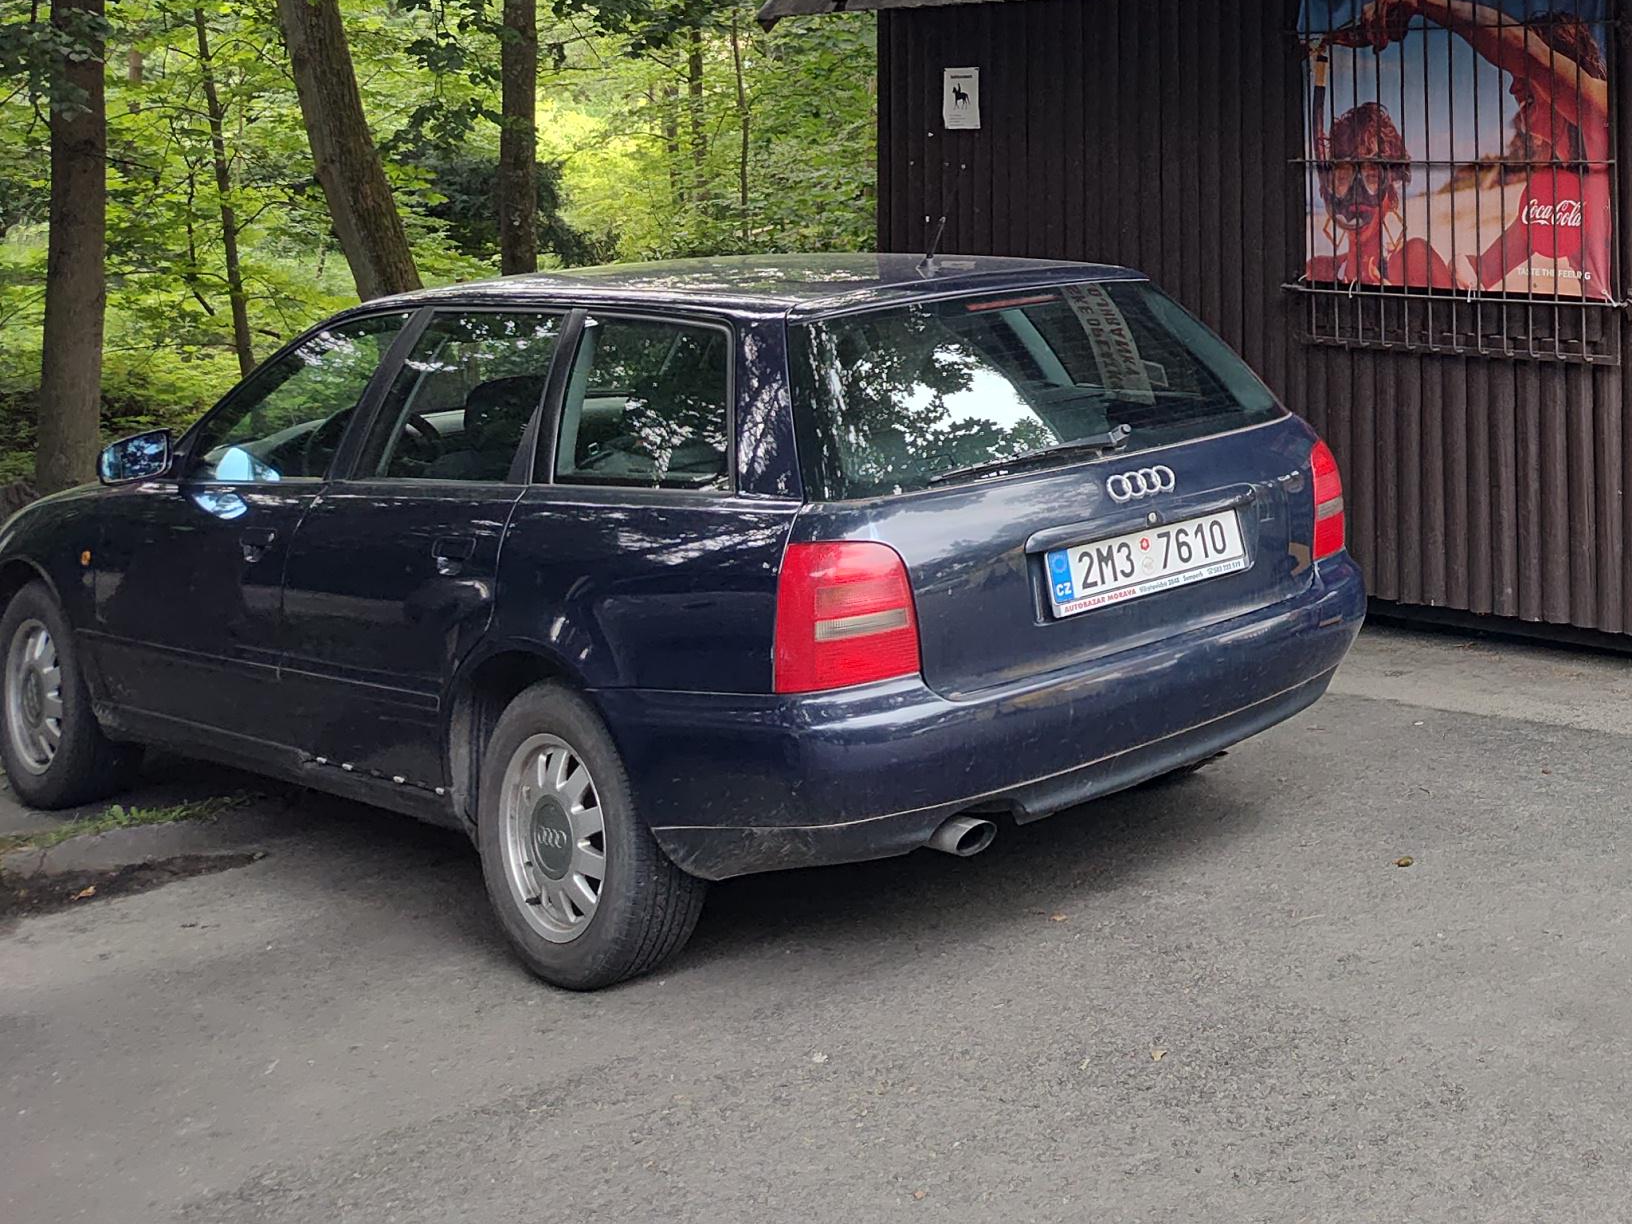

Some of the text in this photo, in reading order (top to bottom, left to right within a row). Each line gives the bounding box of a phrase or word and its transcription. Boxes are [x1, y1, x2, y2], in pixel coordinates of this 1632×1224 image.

[1522, 199, 1584, 227] CocaCola
[1078, 520, 1227, 590] 2M3 7610
[1055, 582, 1072, 597] CZ
[1064, 596, 1106, 613] AUTOBAZAR
[1107, 588, 1137, 603] MORAVA
